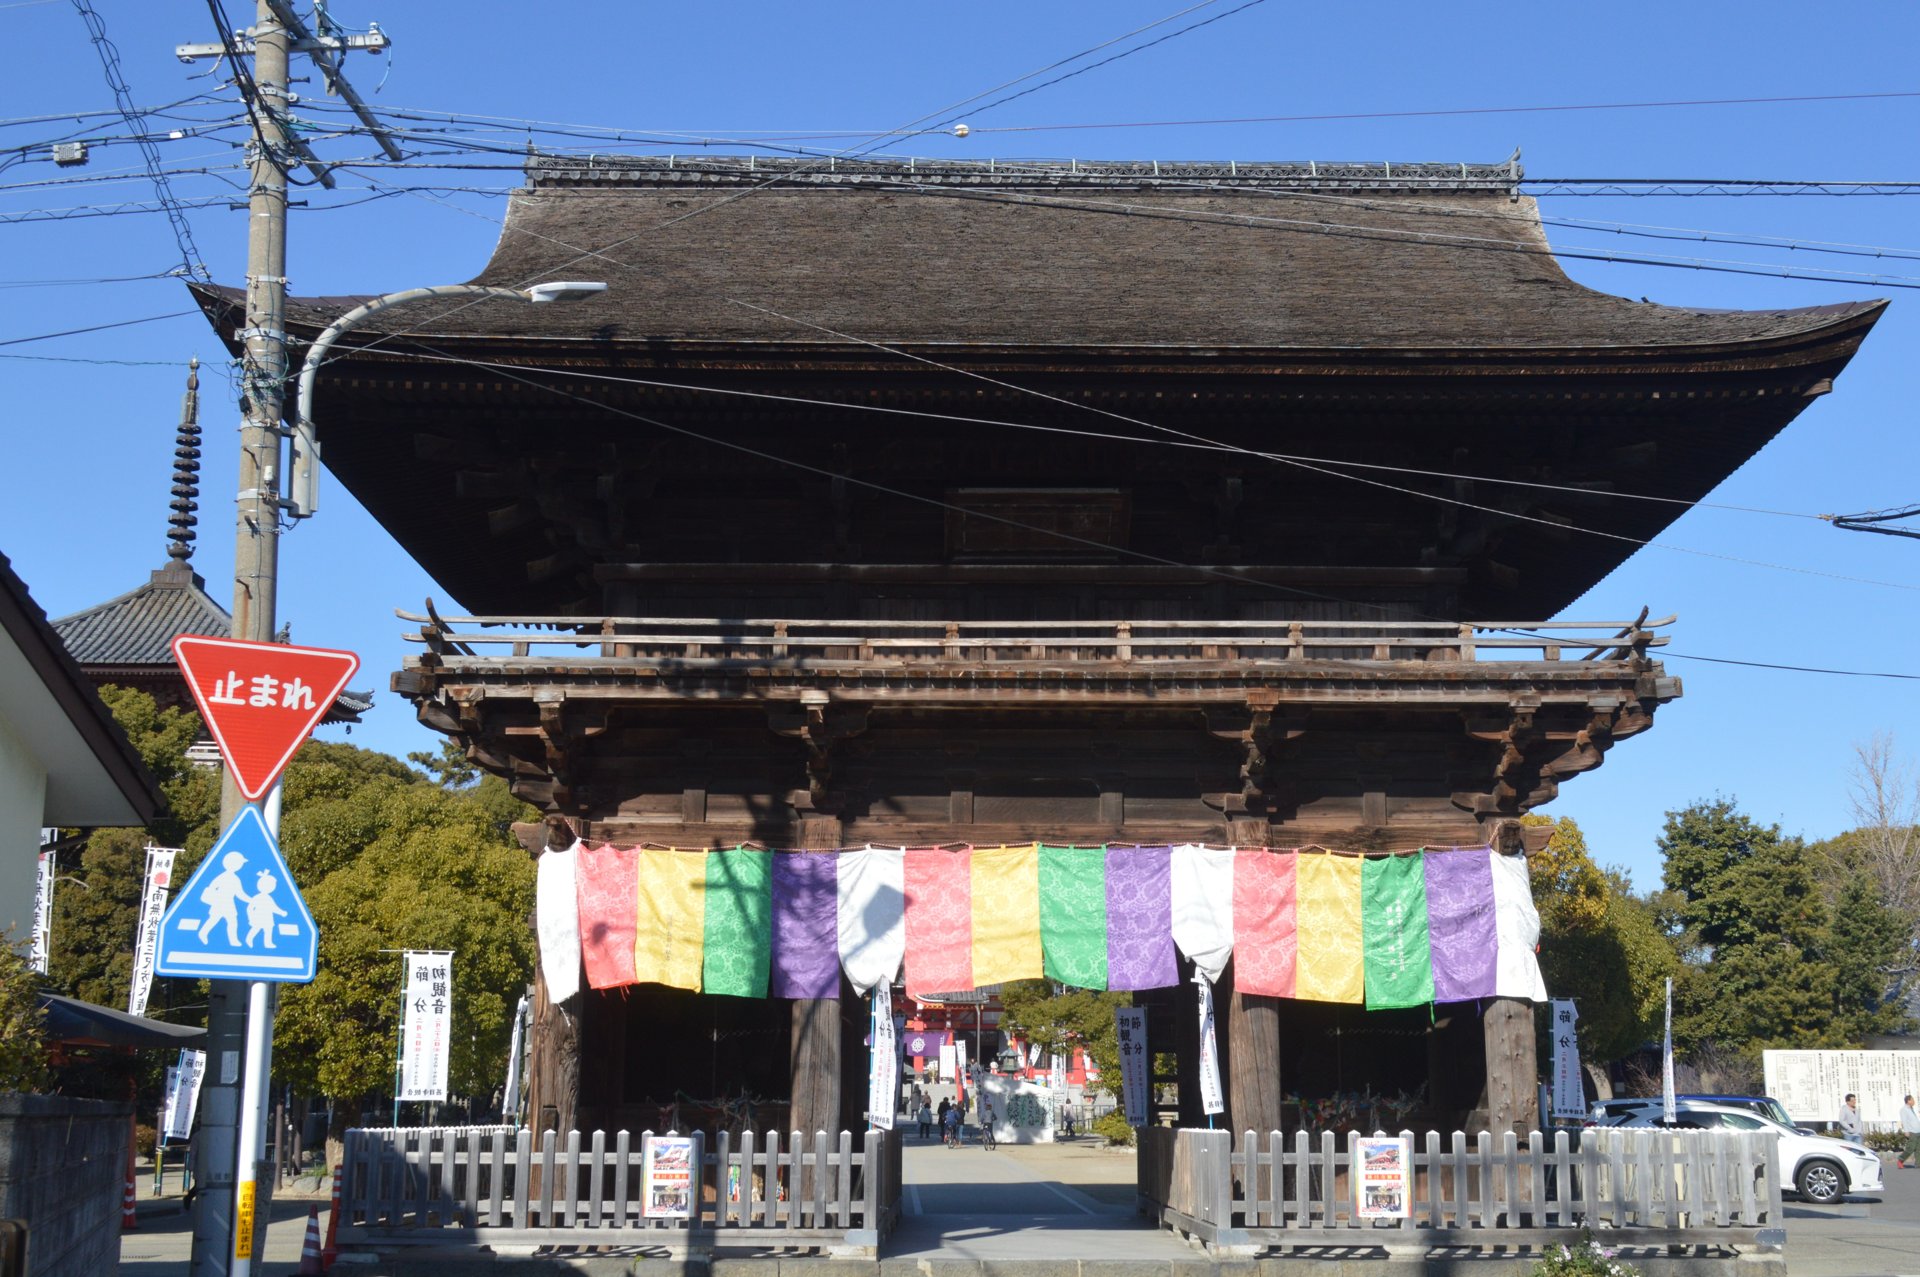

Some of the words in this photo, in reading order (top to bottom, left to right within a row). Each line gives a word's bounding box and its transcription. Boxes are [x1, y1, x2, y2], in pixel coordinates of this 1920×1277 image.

[208, 670, 316, 710] 止まれ
[1120, 1016, 1131, 1055] 初観音
[1132, 1017, 1142, 1054] 節分
